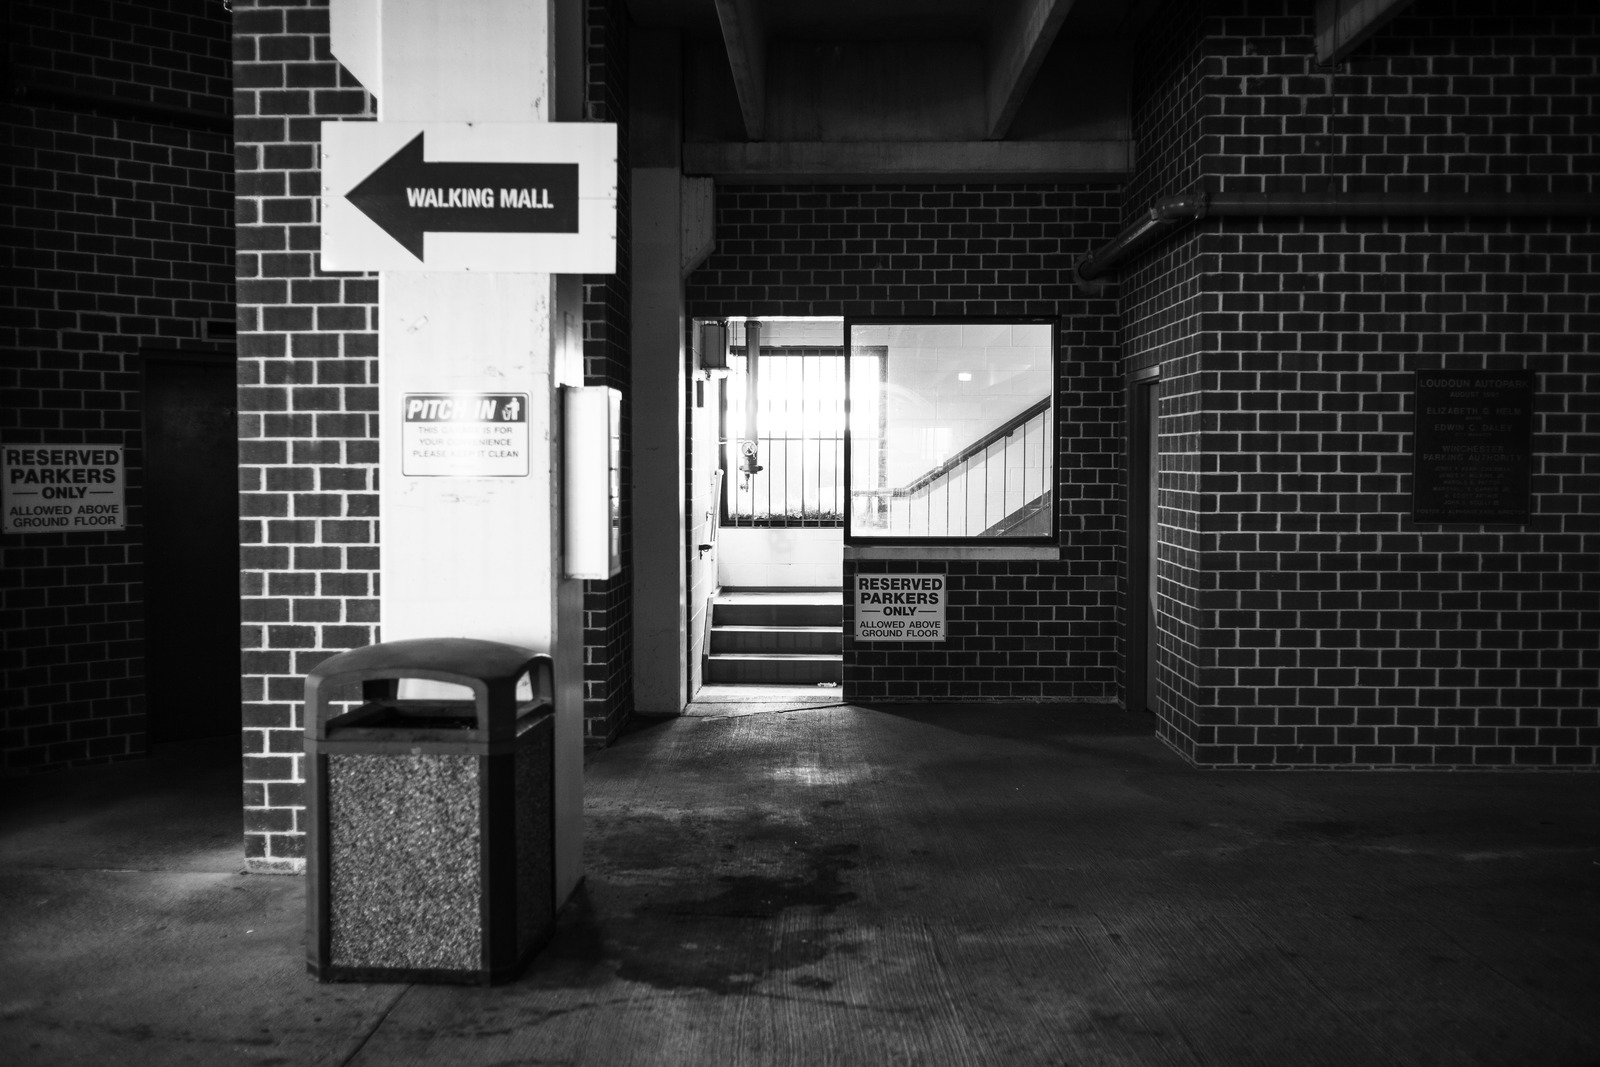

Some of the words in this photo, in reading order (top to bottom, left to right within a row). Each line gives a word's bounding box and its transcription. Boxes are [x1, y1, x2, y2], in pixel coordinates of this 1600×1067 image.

[406, 187, 494, 208] WALKING
[500, 188, 554, 209] MALL
[1419, 379, 1470, 388] LOUDOUN
[1474, 379, 1529, 388] AUTOPARK
[407, 399, 467, 420] PITCH
[472, 399, 497, 420] IN
[1426, 407, 1478, 415] ELIZABETH
[418, 426, 438, 434] THIS
[483, 426, 492, 434] IS
[494, 426, 513, 434] FOR
[1434, 424, 1464, 432] EDWIN
[1482, 424, 1513, 432] DALEY
[420, 438, 443, 446] YOUR
[412, 450, 447, 458] PLEASE
[477, 450, 485, 458] IT
[488, 450, 519, 458] CLEAN
[1441, 445, 1504, 453] WINCHESTER
[6, 449, 119, 466] RESERVED
[1423, 453, 1464, 461] PARKING
[1468, 454, 1521, 462] AUTHORITY
[10, 468, 116, 484] PARKERS
[42, 486, 88, 499] ONLY
[10, 506, 72, 516] ALLOWED
[77, 505, 119, 515] ABOVE
[13, 517, 69, 527] GROUND
[74, 516, 116, 526] FLOOR
[859, 577, 943, 591] RESERVED
[861, 592, 939, 604] PARKERS
[883, 606, 917, 616] ONLY
[862, 629, 902, 637] GROUND
[906, 629, 938, 637] FLOOR
